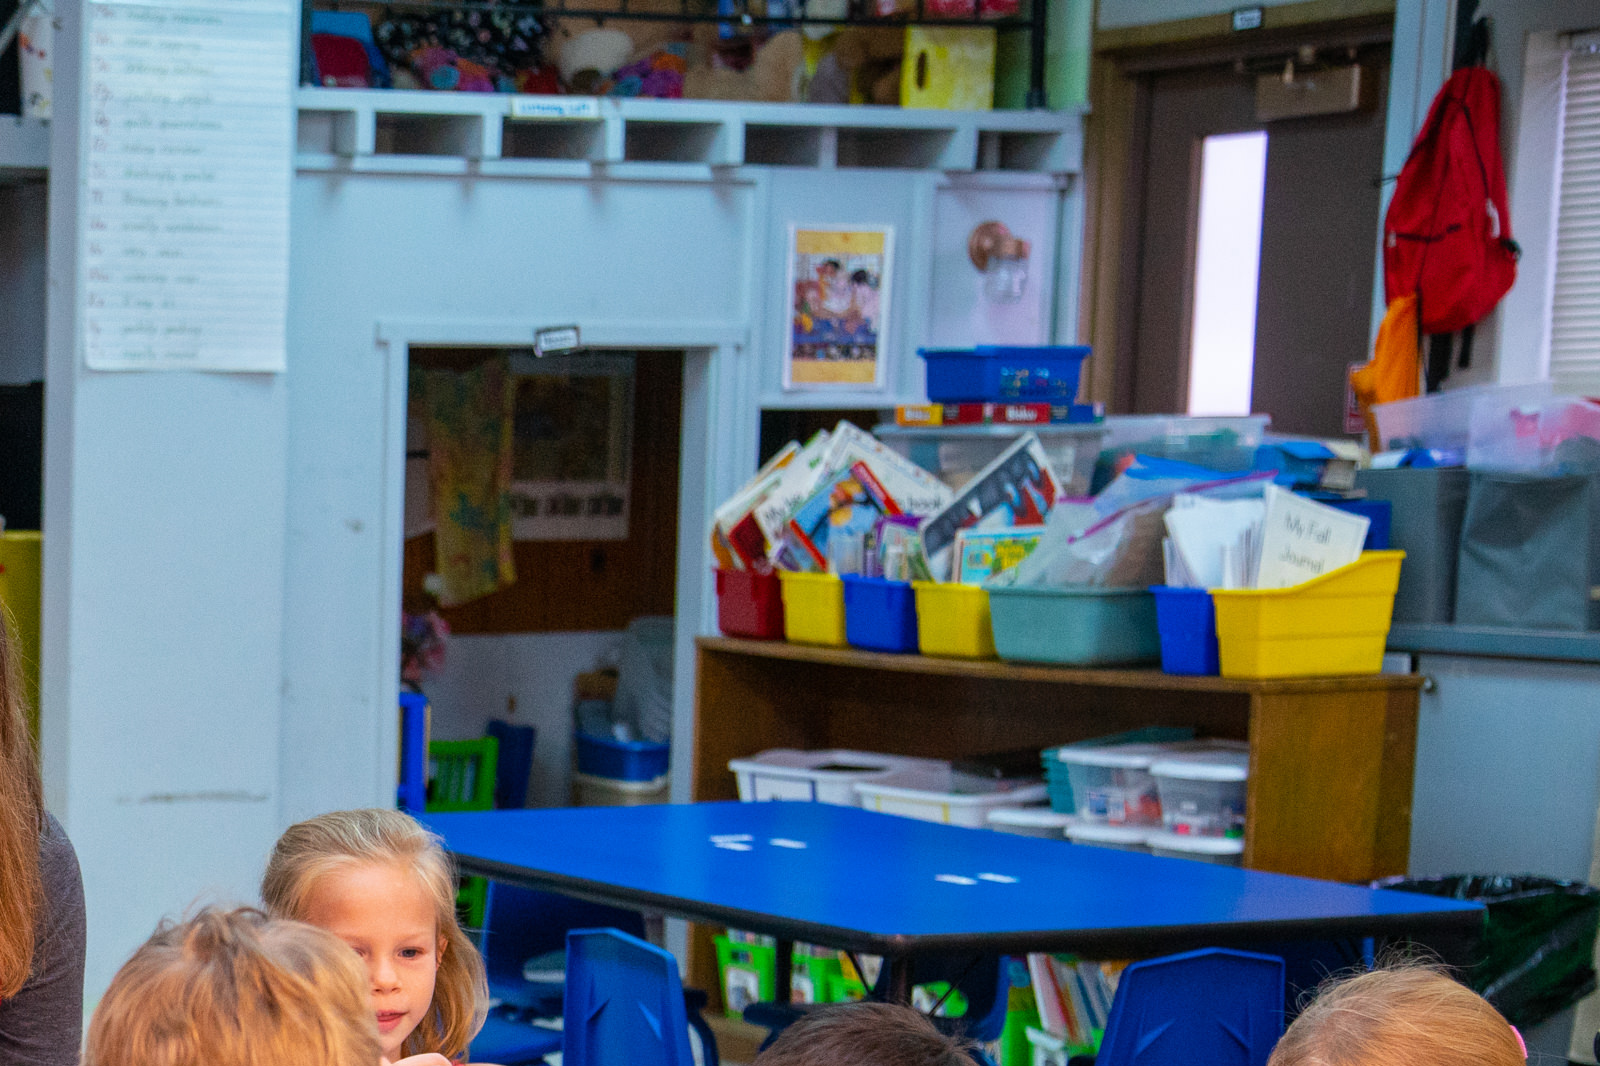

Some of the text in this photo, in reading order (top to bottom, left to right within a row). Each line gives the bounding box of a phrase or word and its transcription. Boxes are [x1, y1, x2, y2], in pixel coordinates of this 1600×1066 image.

[1284, 511, 1332, 545] My Fall
[1279, 546, 1326, 574] Journal
